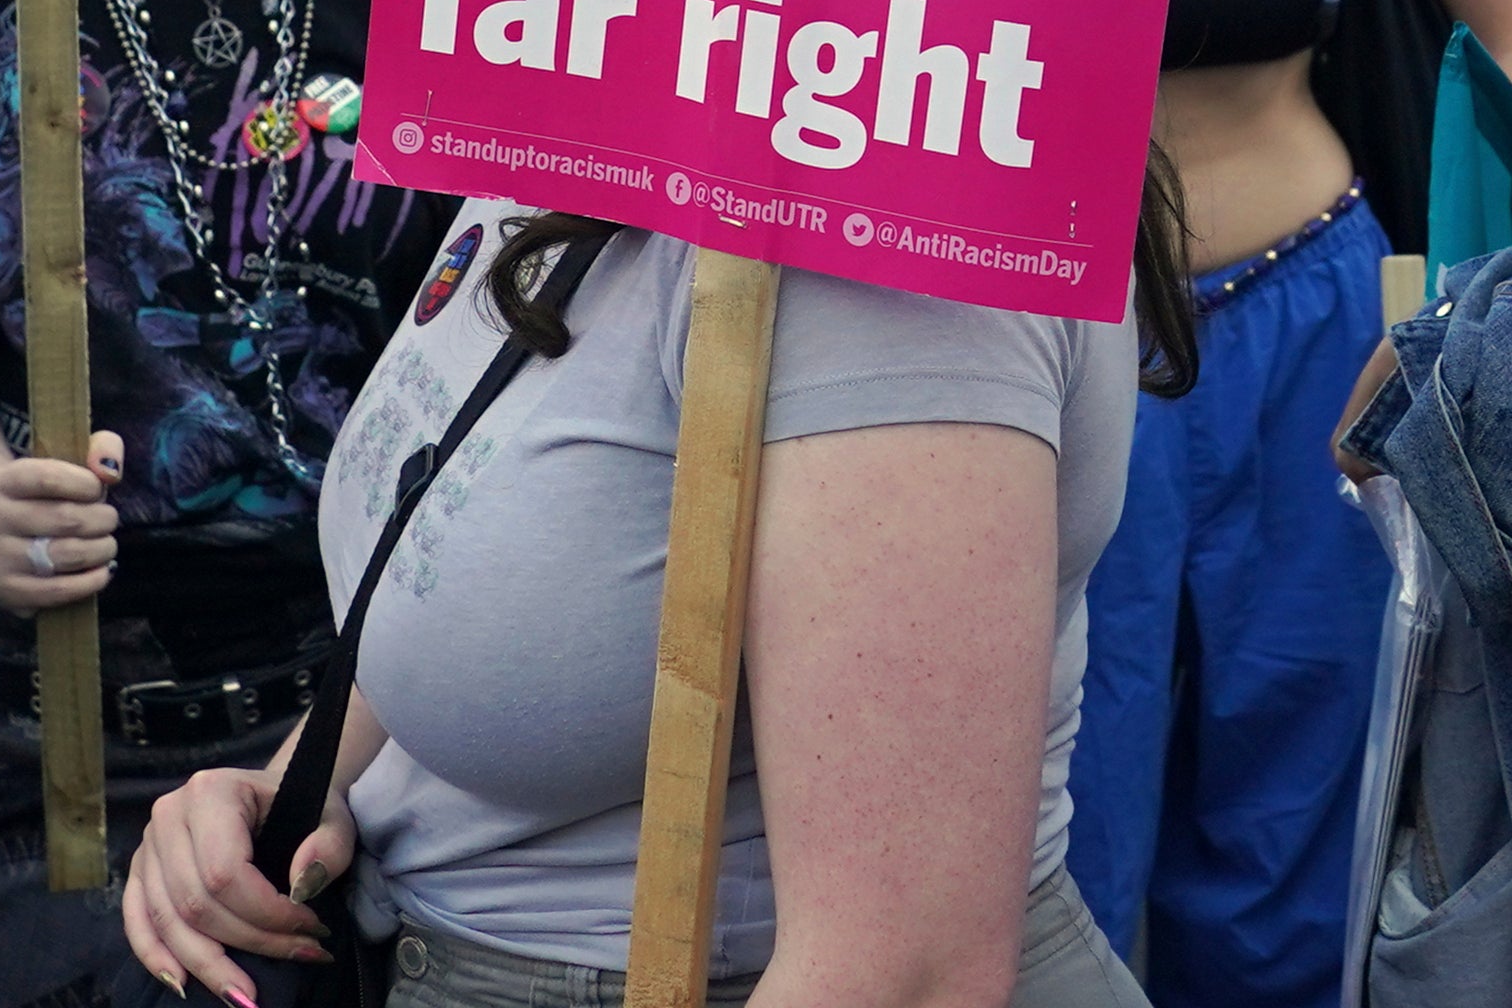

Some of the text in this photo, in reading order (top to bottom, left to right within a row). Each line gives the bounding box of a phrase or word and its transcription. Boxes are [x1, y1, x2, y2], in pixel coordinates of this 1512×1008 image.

[430, 132, 1086, 286] standuptoracismuk @StandUTR @AntiRacismDay
